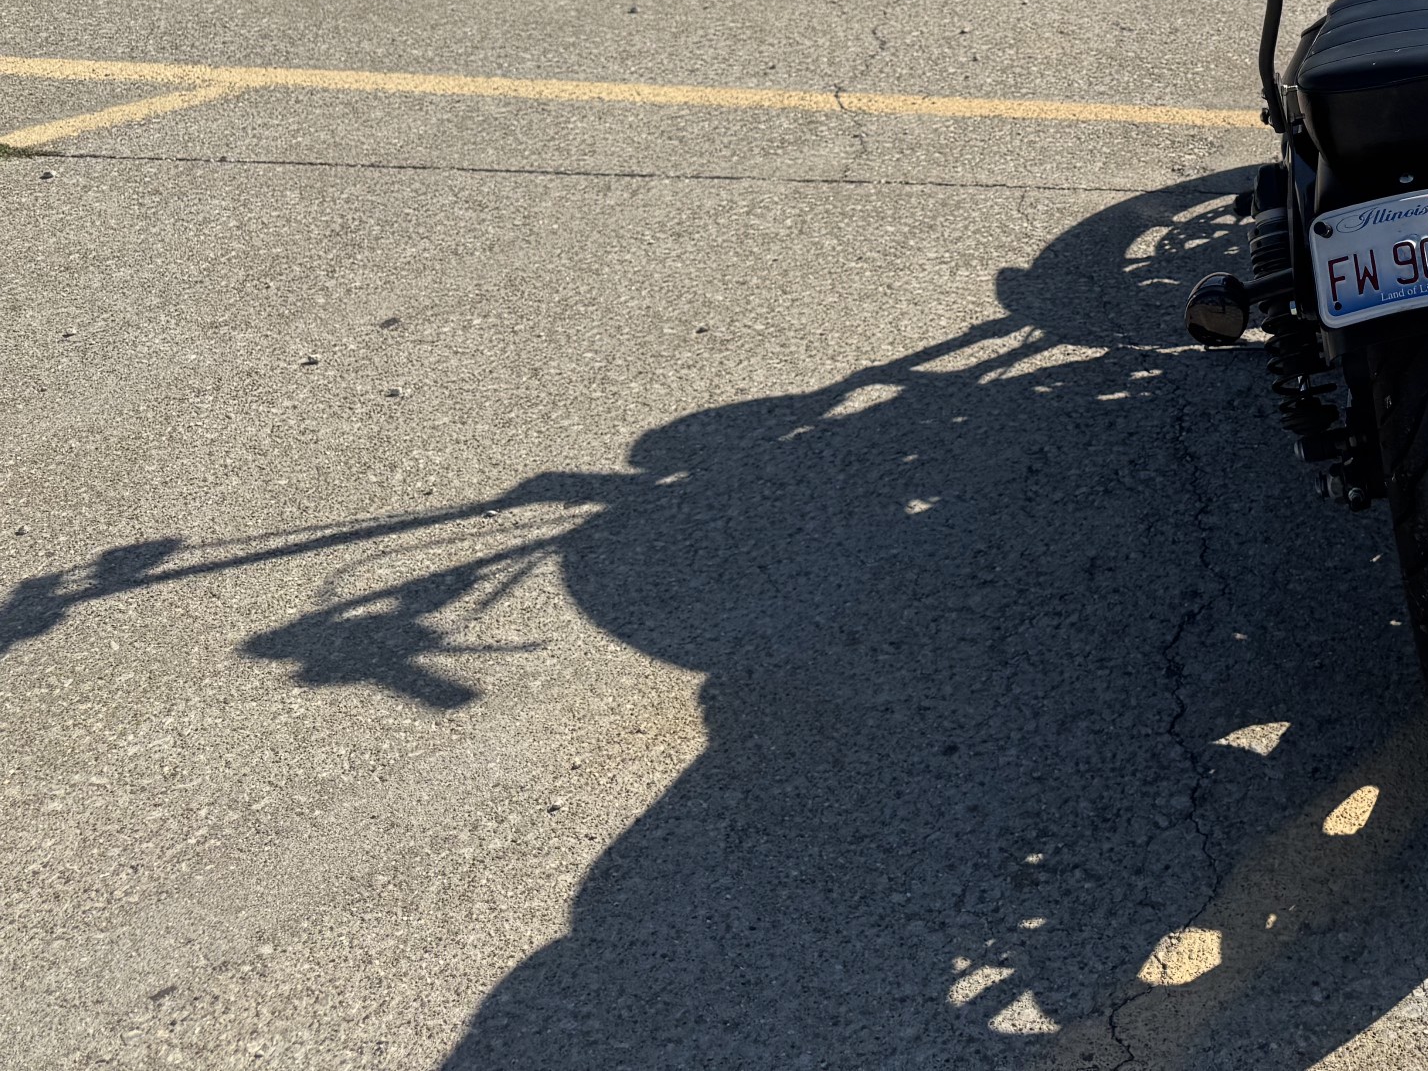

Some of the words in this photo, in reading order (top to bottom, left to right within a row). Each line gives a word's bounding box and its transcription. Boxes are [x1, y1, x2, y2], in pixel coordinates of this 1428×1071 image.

[1327, 249, 1380, 302] FW
[1381, 287, 1405, 302] Land
[1407, 285, 1417, 295] of
